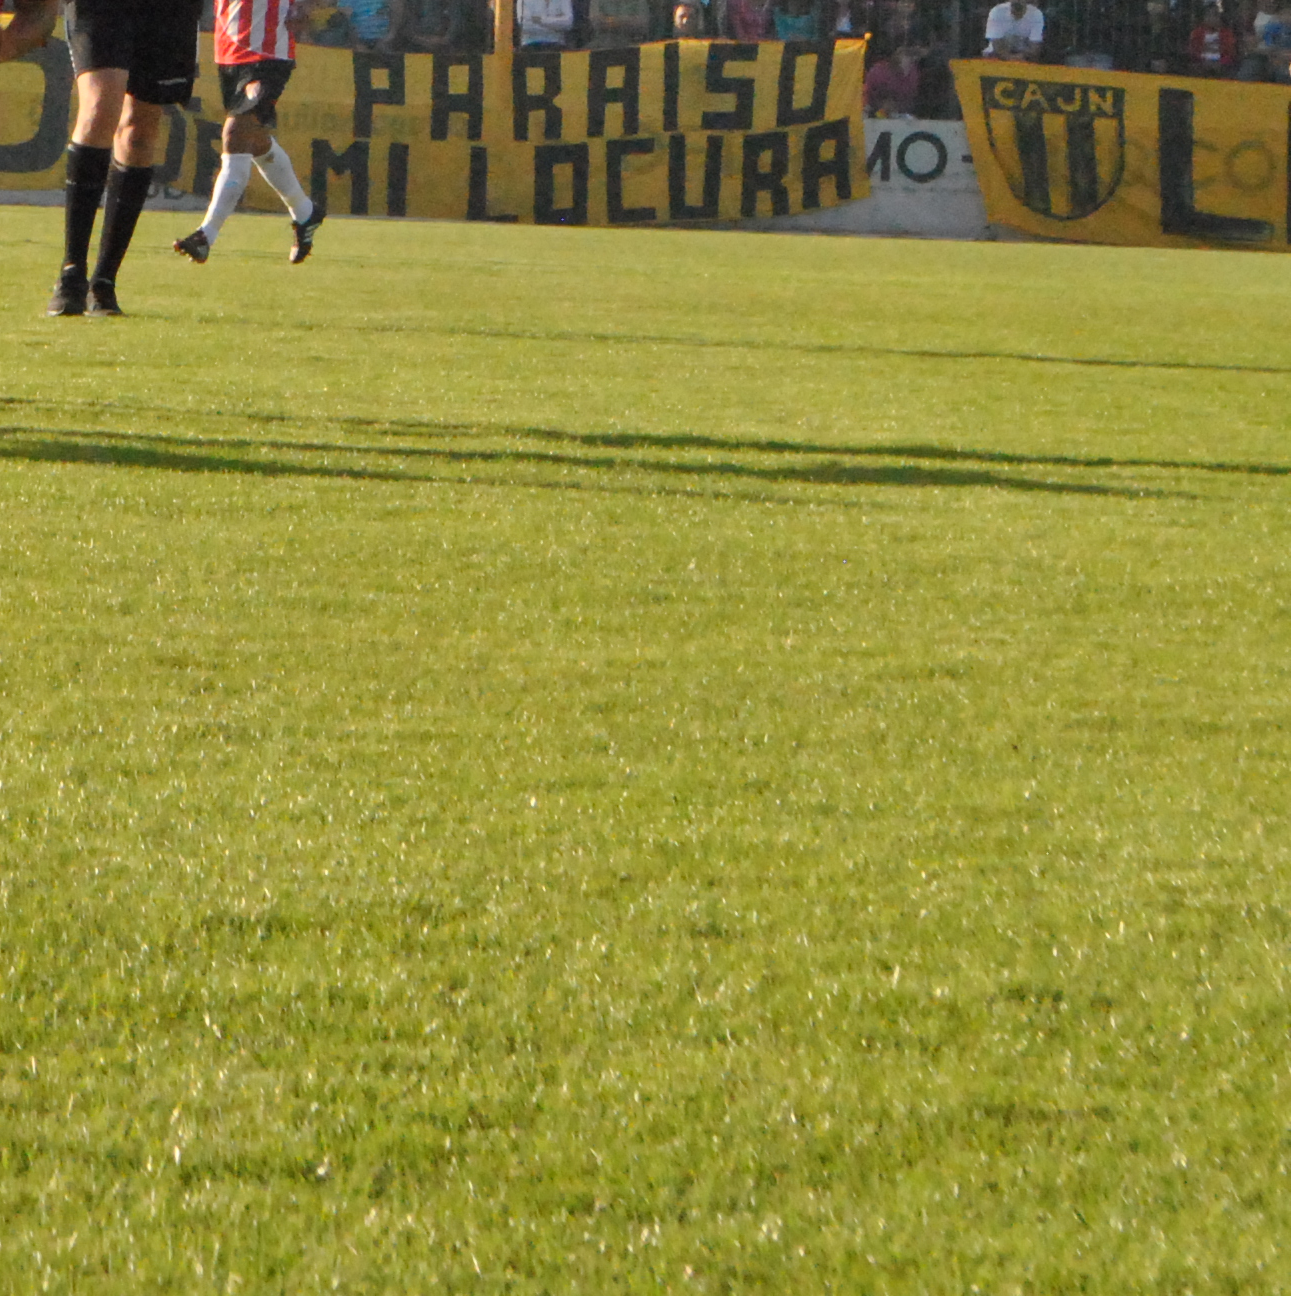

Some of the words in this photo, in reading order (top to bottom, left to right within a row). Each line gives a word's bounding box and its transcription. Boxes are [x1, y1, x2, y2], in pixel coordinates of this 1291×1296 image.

[352, 39, 836, 142] PARAISO
[994, 82, 1116, 116] CAJN
[310, 138, 409, 218] MI
[467, 117, 851, 226] LOCURA
